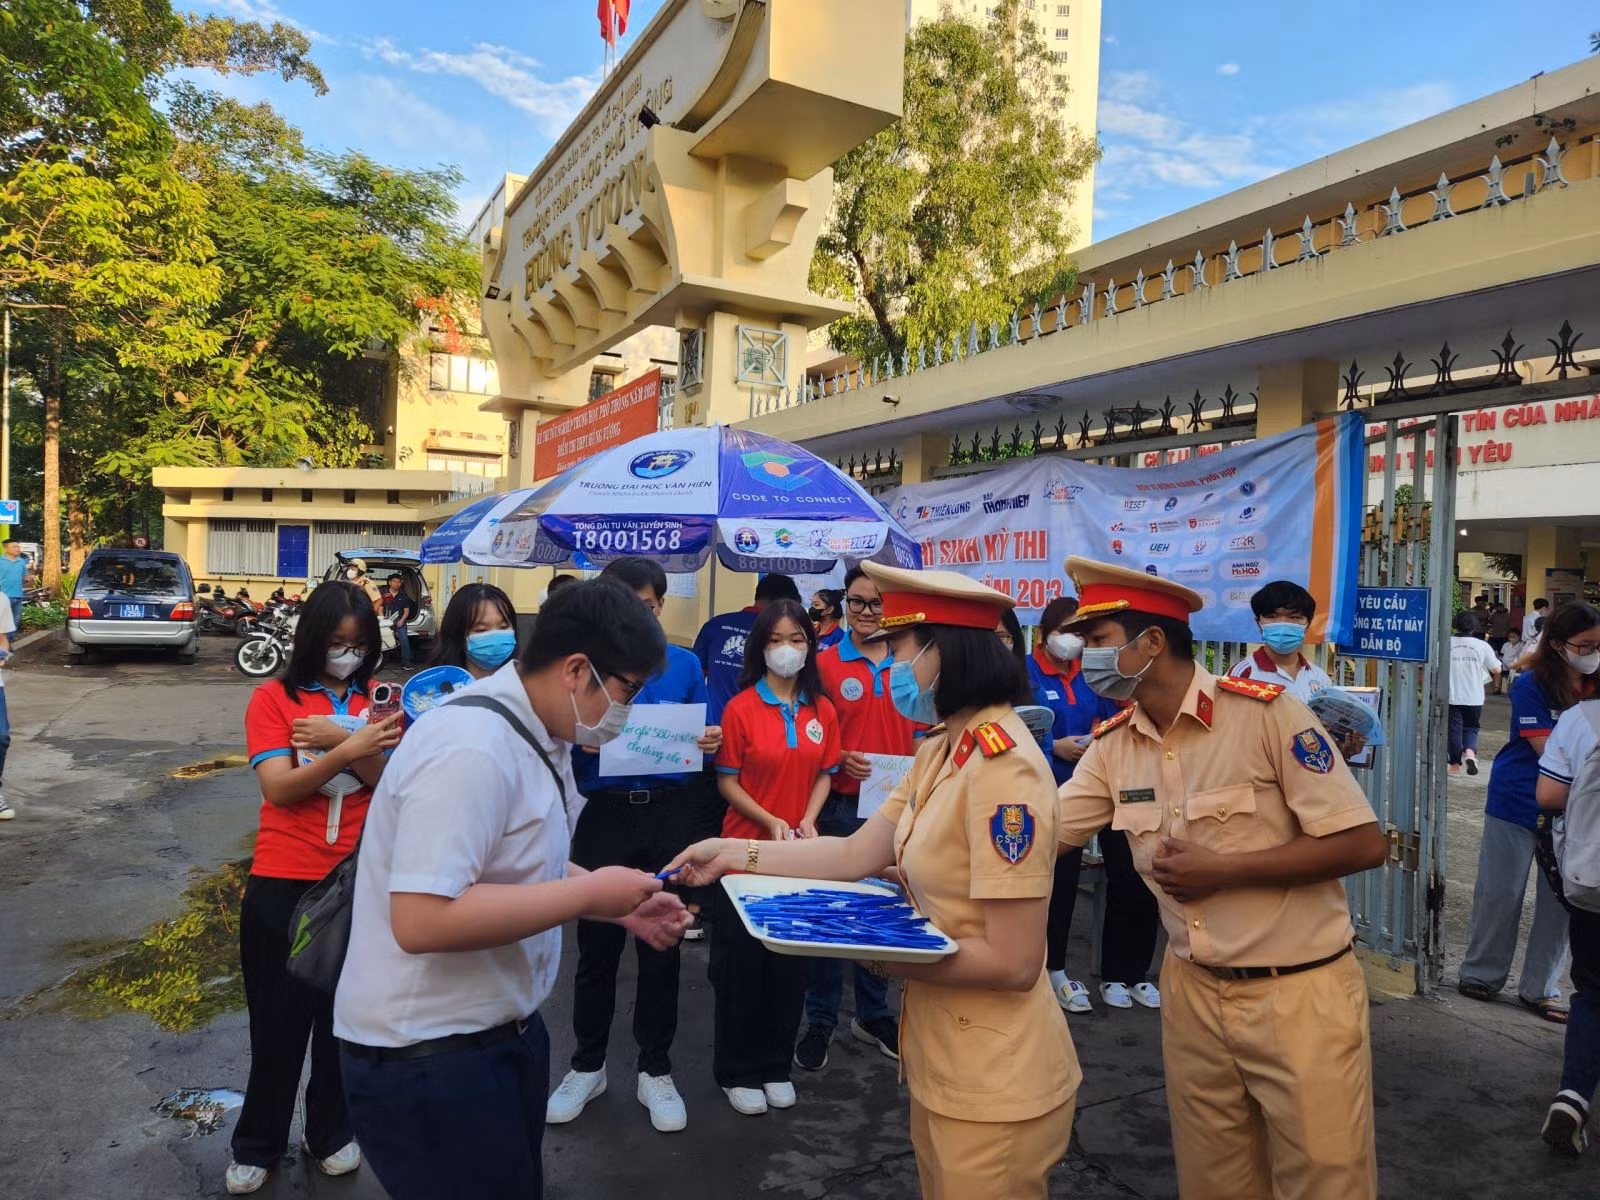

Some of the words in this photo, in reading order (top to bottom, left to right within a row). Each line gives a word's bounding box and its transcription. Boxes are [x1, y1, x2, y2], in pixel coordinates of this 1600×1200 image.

[1462, 407, 1496, 432] TÍN
[1503, 402, 1547, 428] CỦA
[1468, 439, 1512, 464] YÊU
[732, 492, 768, 502] CODE
[773, 495, 790, 503] TO
[796, 496, 853, 504] CONNECT
[597, 521, 610, 530] ĐÀI
[664, 521, 683, 529] SINH
[572, 529, 682, 550] 18001568
[852, 535, 876, 548] 2023
[939, 536, 981, 566] SINH
[984, 527, 1010, 562] KỲ
[1013, 529, 1047, 560] THI
[1149, 543, 1170, 552] UEH
[1360, 594, 1381, 609] YÊU
[1383, 592, 1407, 610] CẦU
[1371, 617, 1385, 632] XE,
[1386, 613, 1403, 631] TẮT
[1404, 616, 1423, 632] MÁY
[1360, 632, 1383, 651] DẪN
[1386, 637, 1402, 655] BỘ
